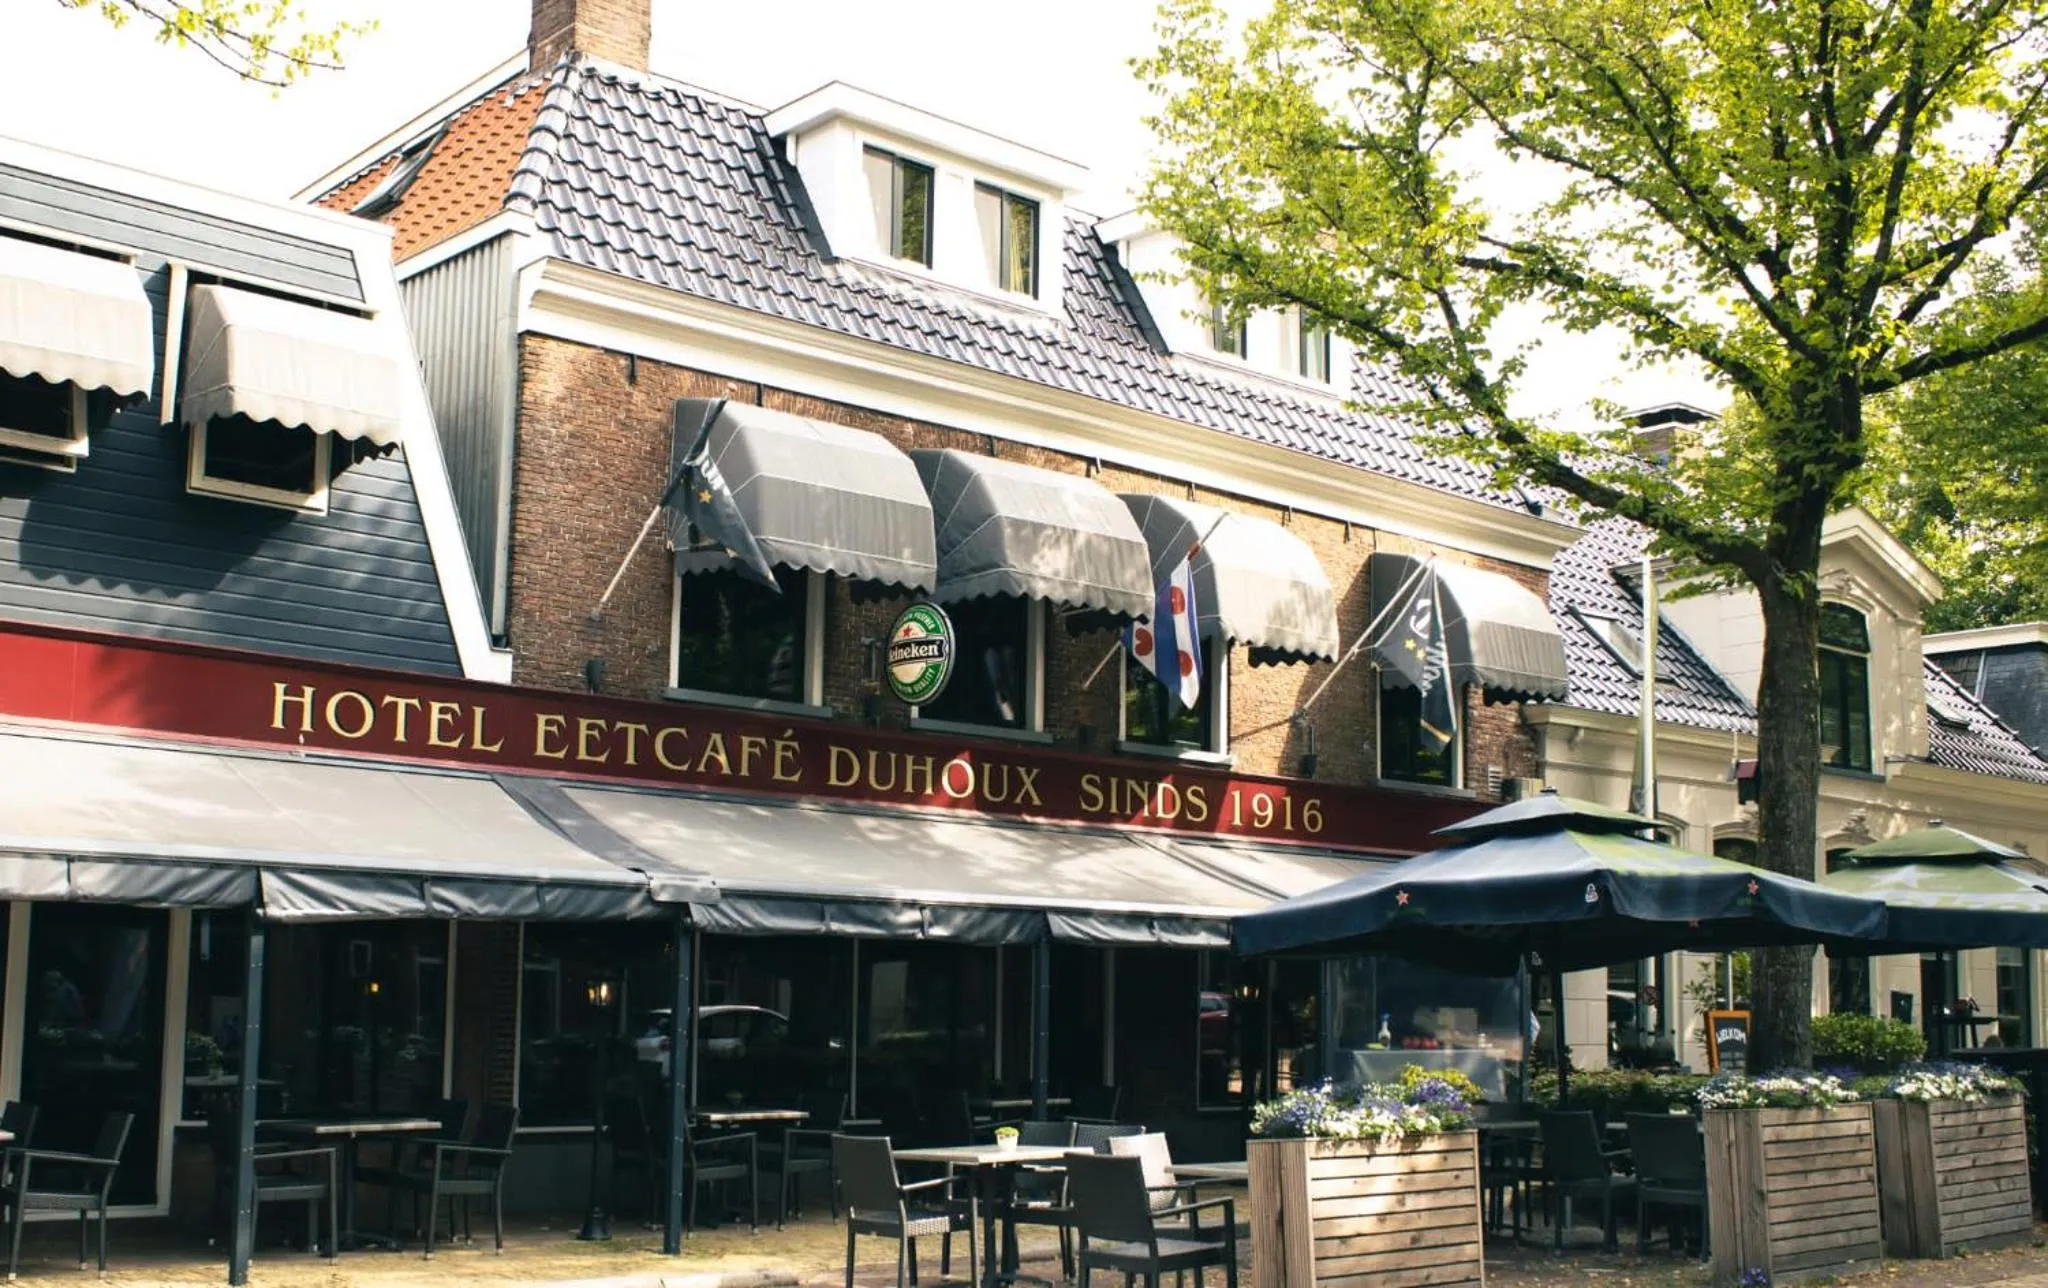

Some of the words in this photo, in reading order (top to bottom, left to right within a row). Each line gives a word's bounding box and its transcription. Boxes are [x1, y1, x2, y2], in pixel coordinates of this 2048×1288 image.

[271, 681, 505, 753] HOTEL
[534, 713, 804, 782] EETCAFÉ
[827, 746, 1042, 806] DUHOUX
[1080, 774, 1209, 823] SINDS
[1230, 789, 1323, 833] 1916
